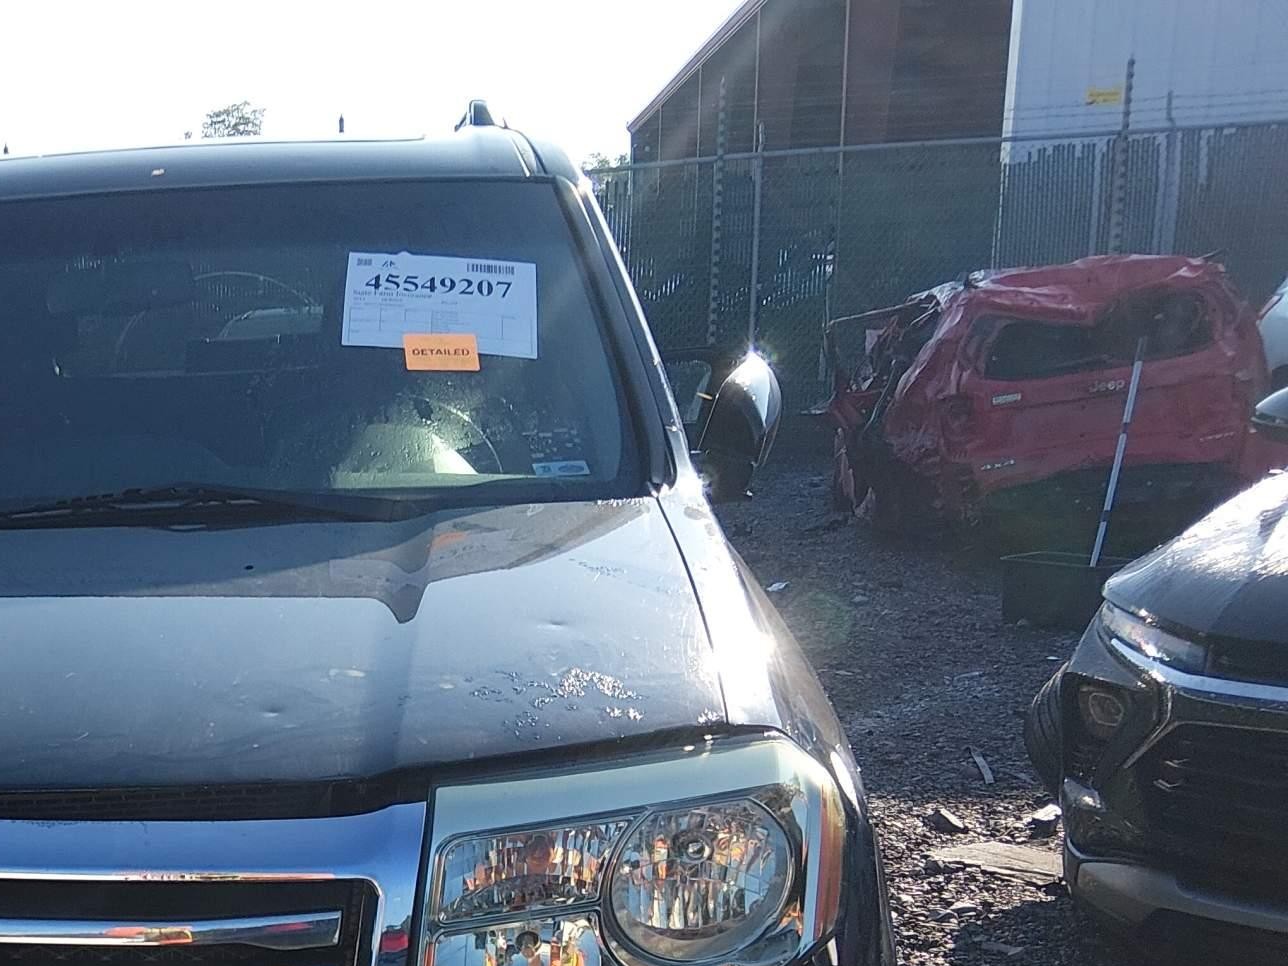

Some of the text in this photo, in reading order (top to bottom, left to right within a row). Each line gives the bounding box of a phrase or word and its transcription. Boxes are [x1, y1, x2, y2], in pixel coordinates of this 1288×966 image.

[365, 273, 513, 299] 45549207
[412, 347, 471, 357] DETAILED
[1087, 378, 1126, 393] Jeep
